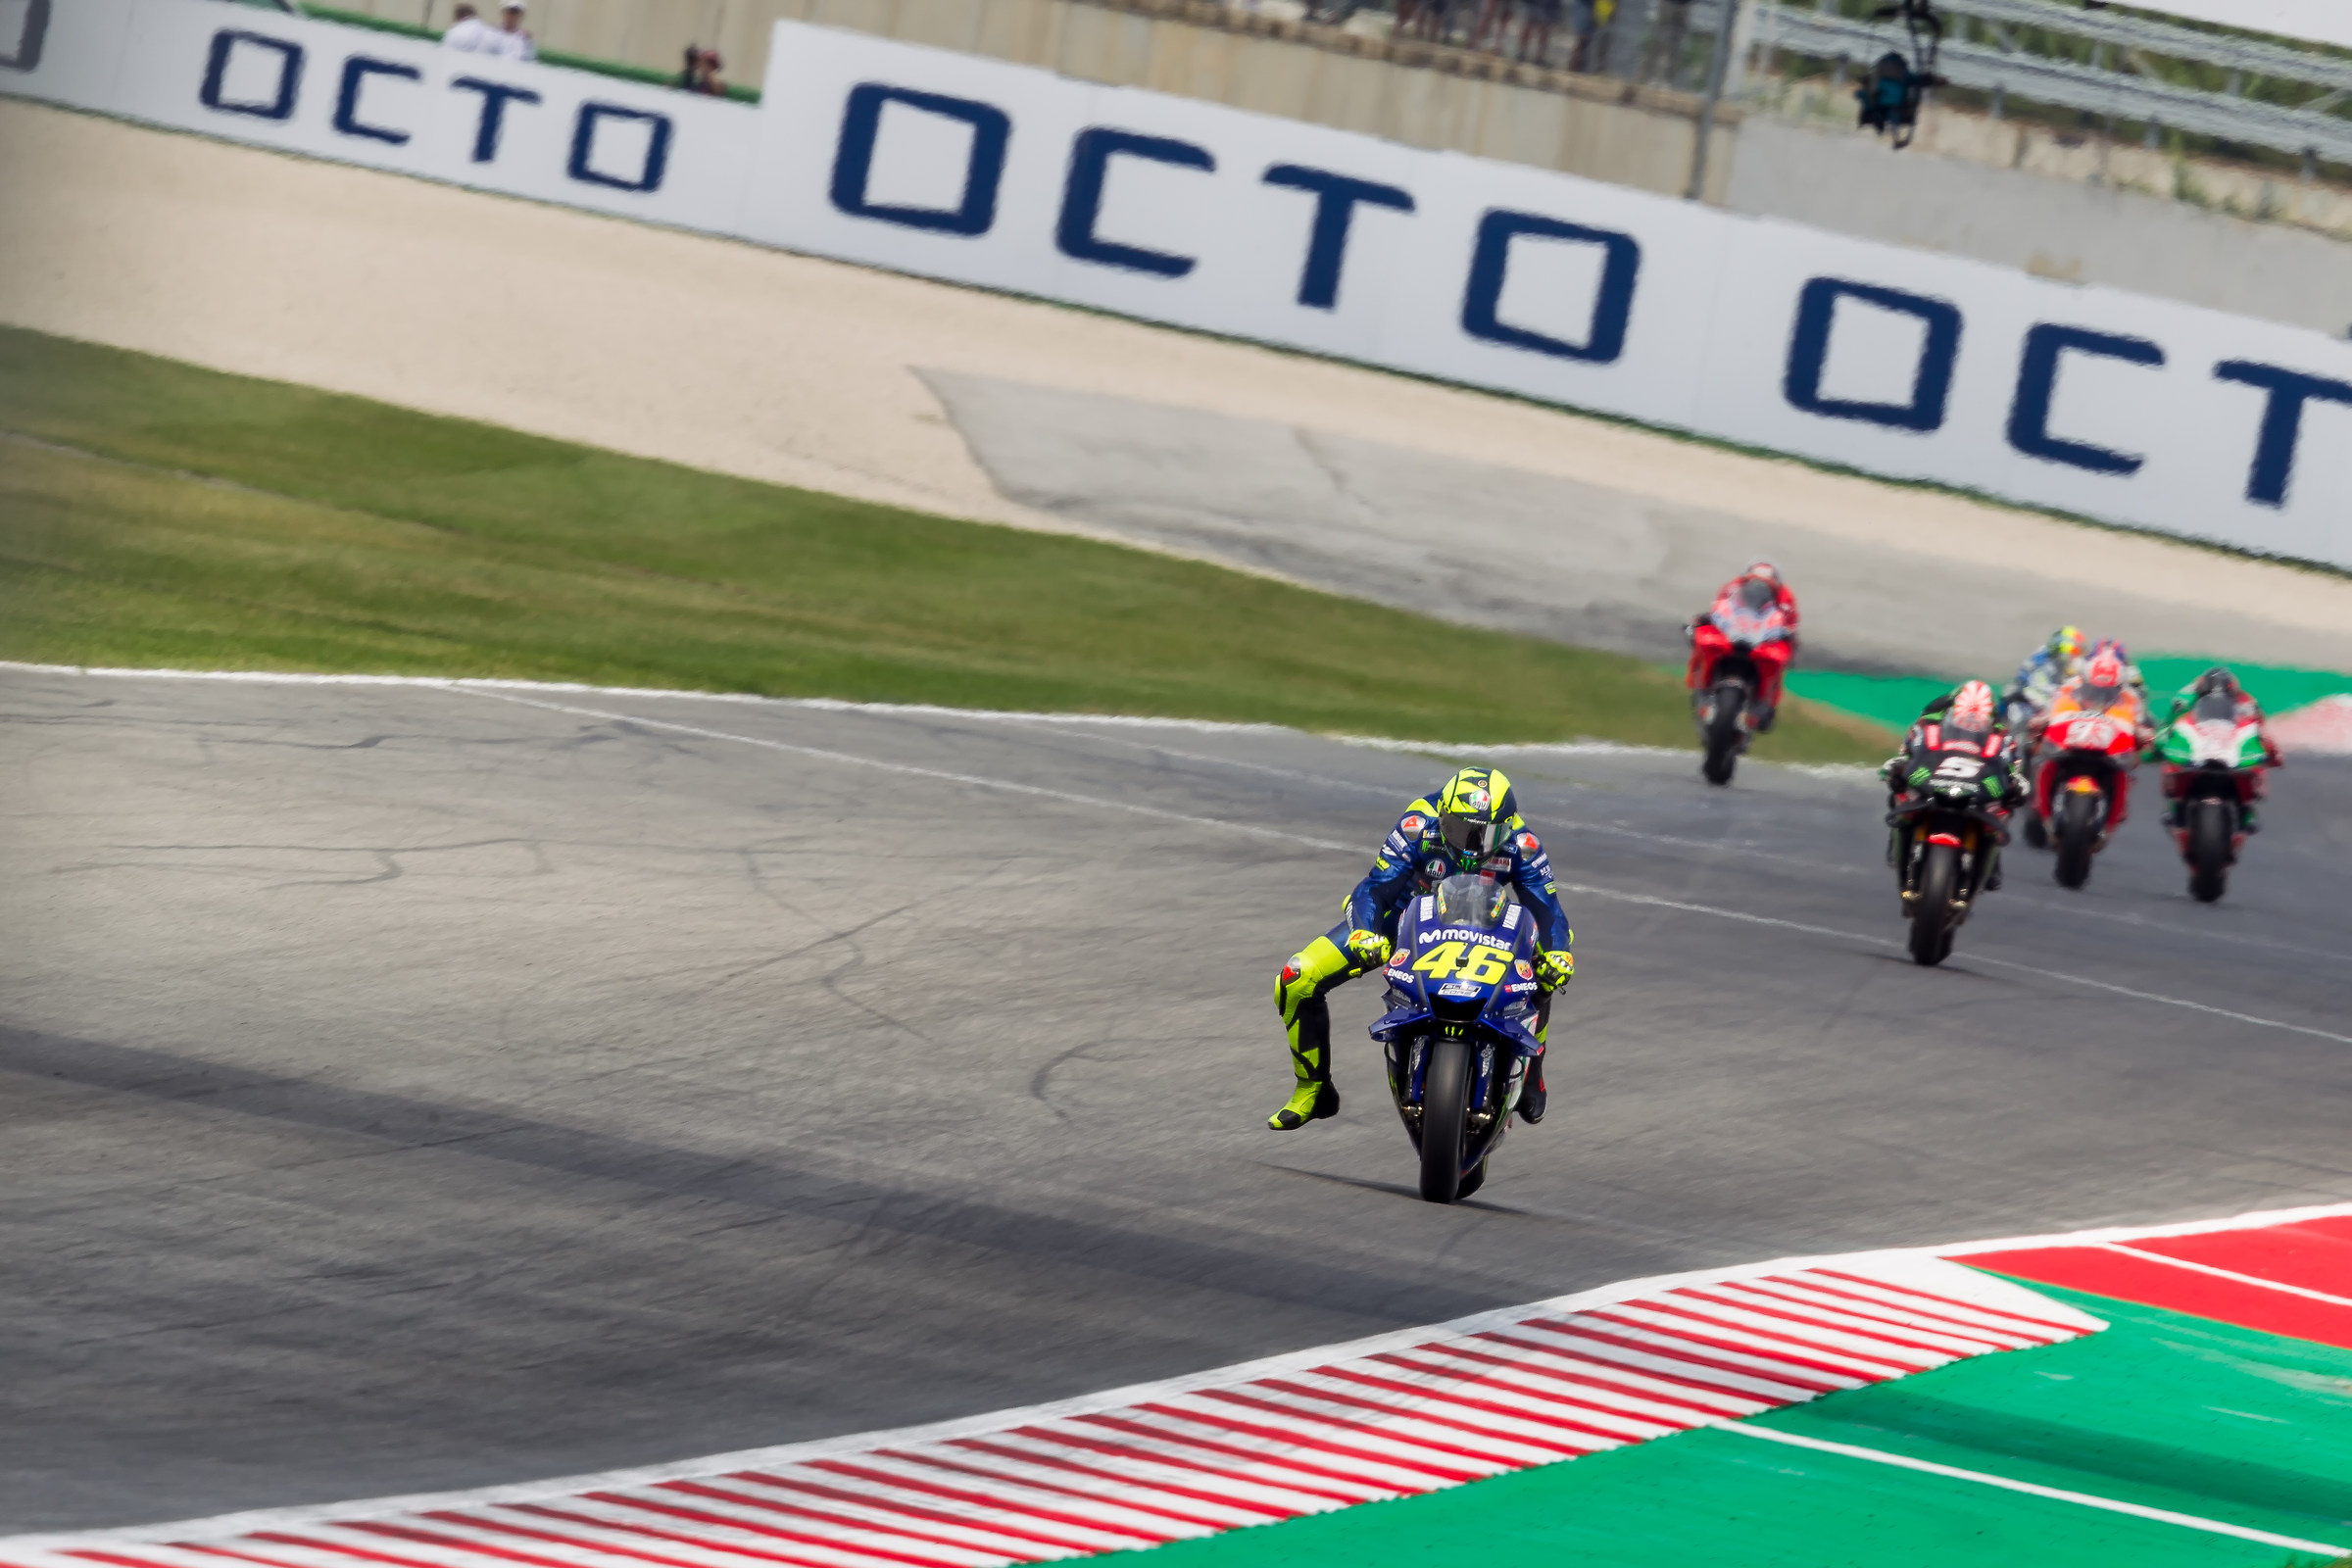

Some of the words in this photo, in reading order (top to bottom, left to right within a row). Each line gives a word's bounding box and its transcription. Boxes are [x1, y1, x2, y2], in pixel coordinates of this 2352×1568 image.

[200, 29, 671, 192] OCTO
[830, 83, 1641, 365] OCTO
[1442, 929, 1512, 951] movistar
[1388, 967, 1414, 984] ENEOS
[1411, 941, 1515, 986] 46
[1510, 982, 1538, 993] ENEOS
